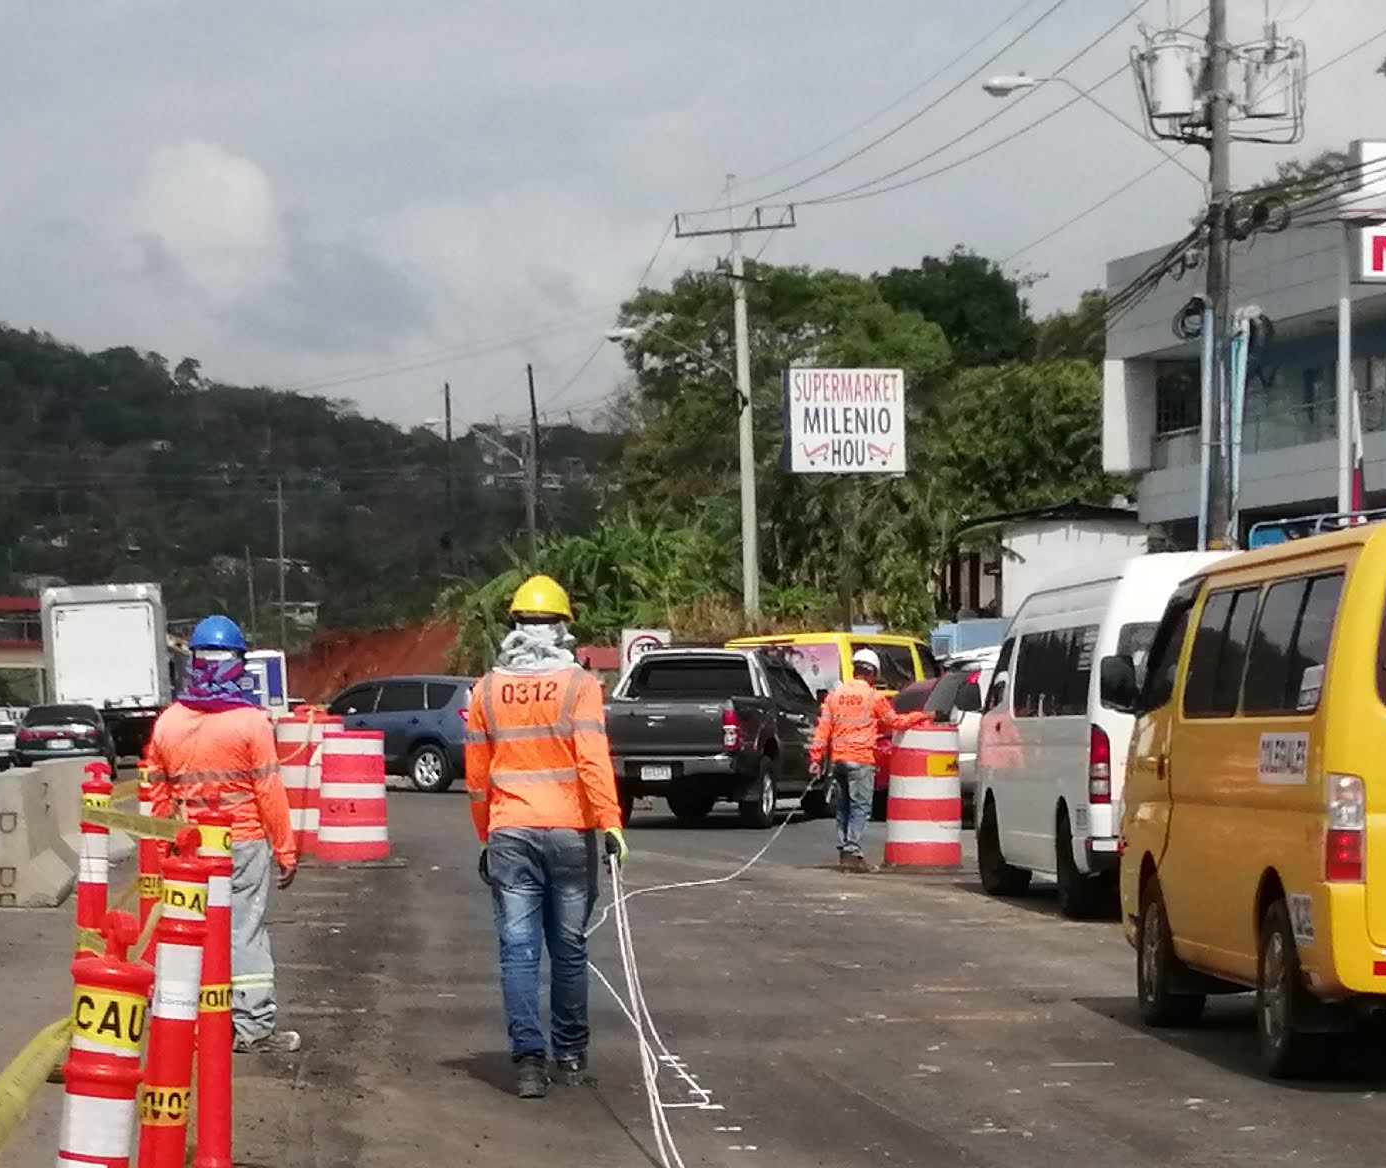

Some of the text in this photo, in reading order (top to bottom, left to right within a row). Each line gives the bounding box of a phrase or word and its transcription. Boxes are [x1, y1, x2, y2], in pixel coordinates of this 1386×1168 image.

[794, 372, 898, 402] SUPERMARKET
[803, 407, 891, 434] MILENIO
[831, 439, 865, 466] HOU
[501, 680, 558, 704] 0312
